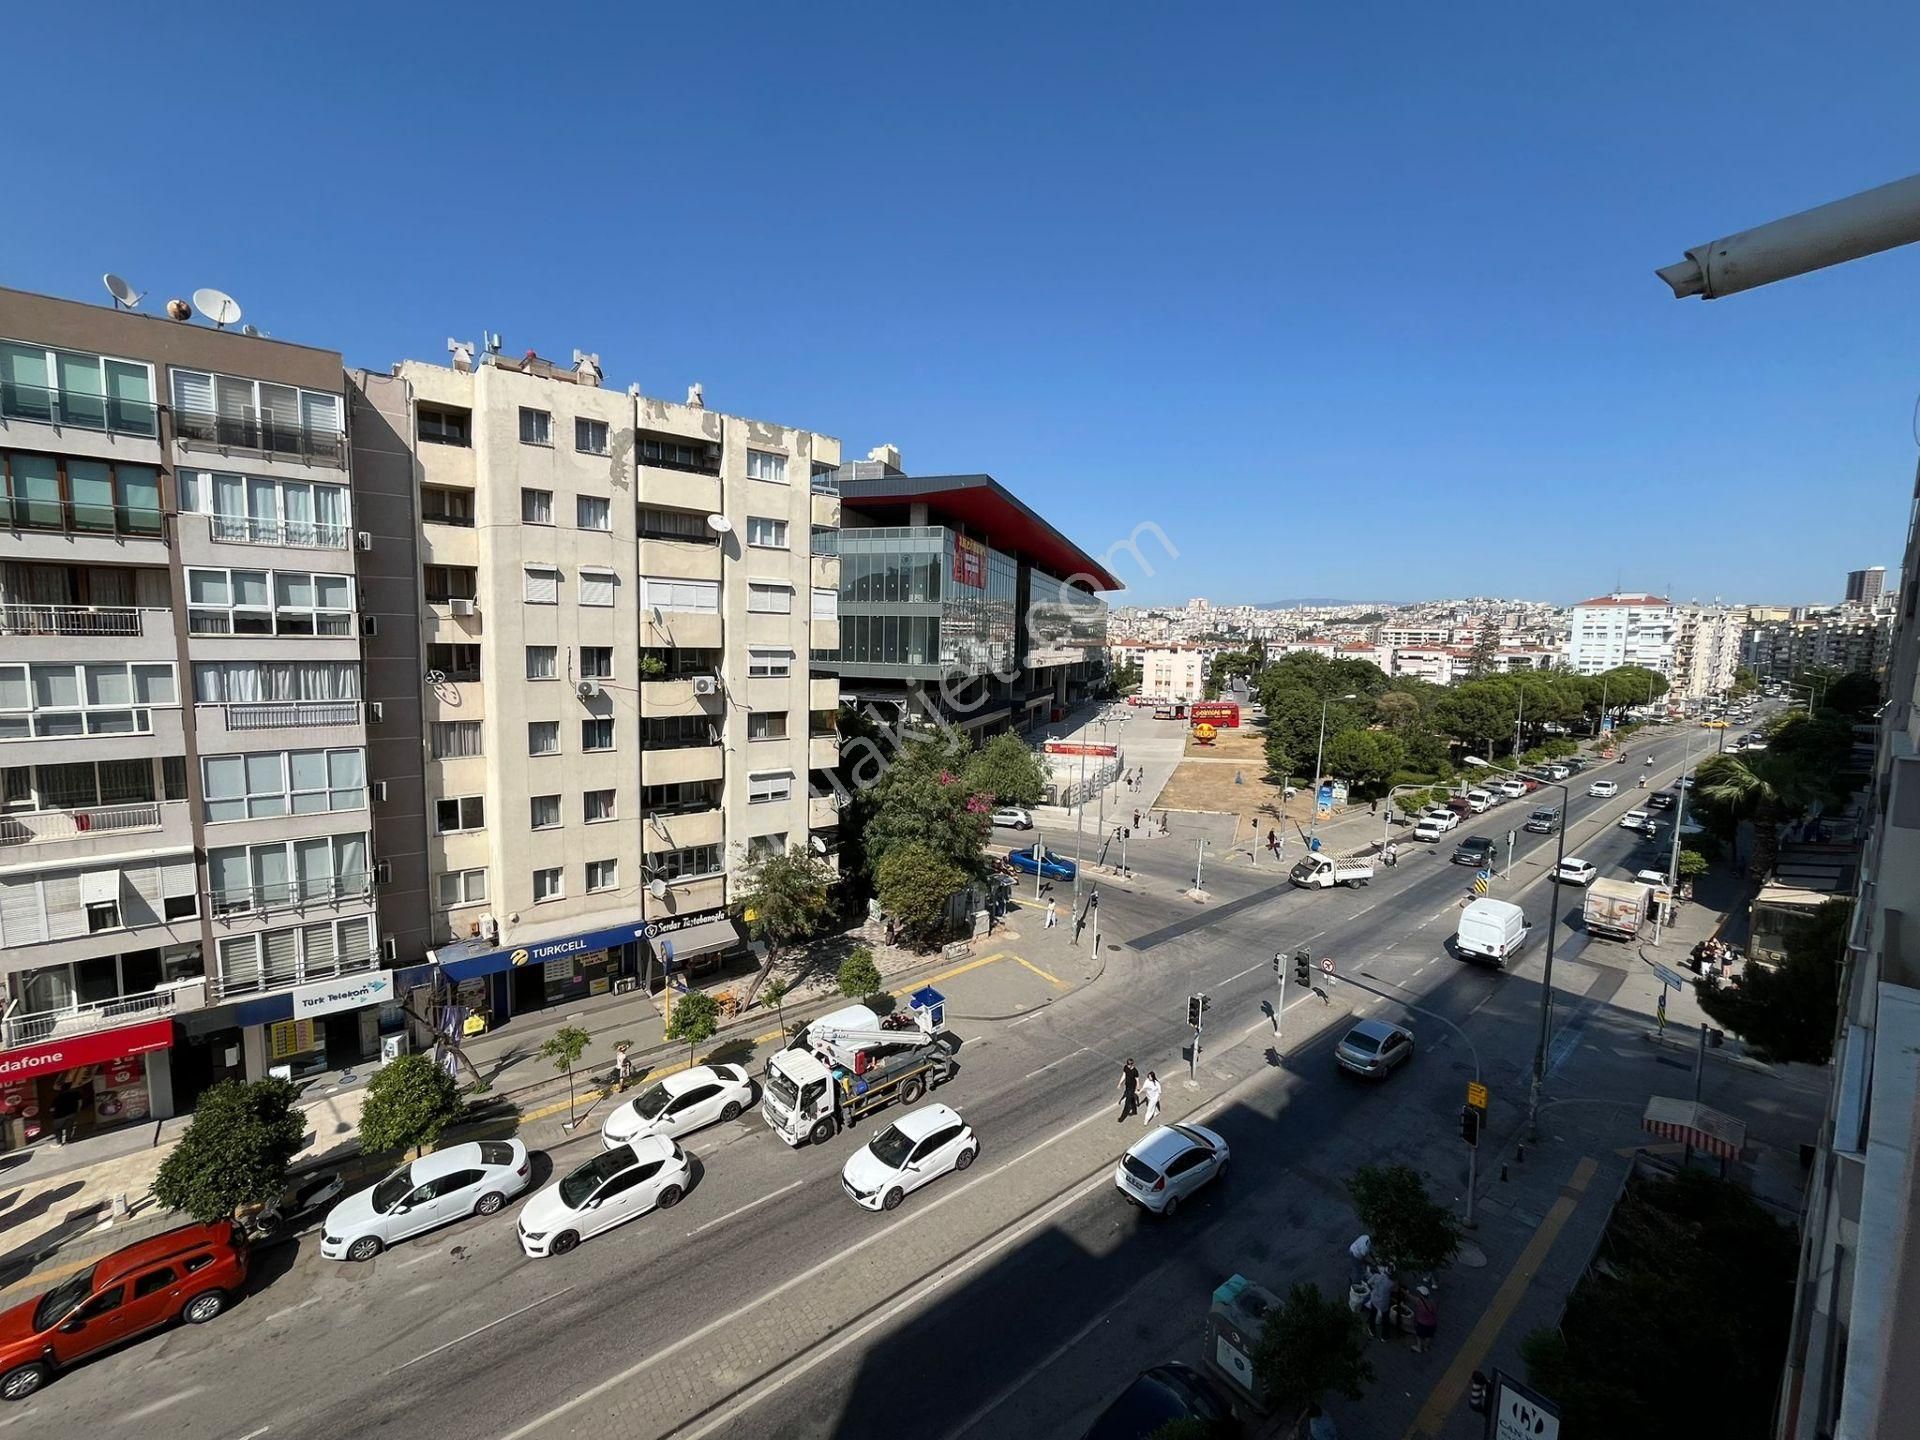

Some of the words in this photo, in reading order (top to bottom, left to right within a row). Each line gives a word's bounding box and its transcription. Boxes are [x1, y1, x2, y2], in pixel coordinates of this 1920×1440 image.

[658, 920, 681, 933] Serdar
[533, 939, 587, 959] TURKCELL
[302, 996, 325, 1007] Türk
[327, 986, 369, 1002] Telekom
